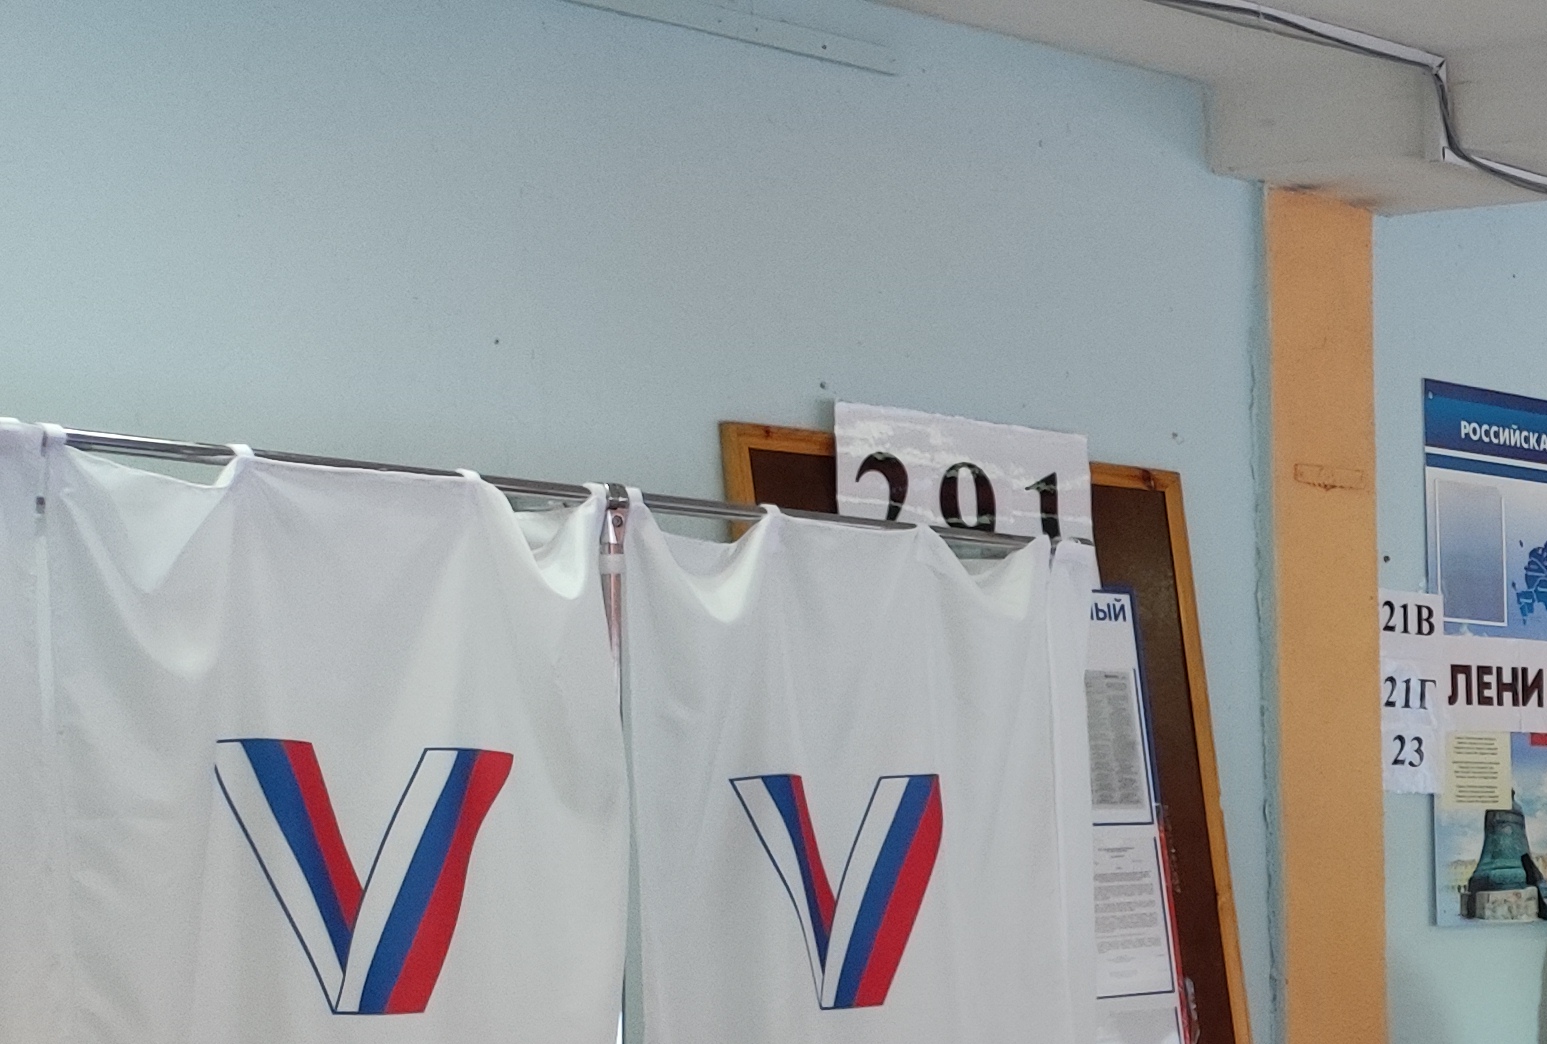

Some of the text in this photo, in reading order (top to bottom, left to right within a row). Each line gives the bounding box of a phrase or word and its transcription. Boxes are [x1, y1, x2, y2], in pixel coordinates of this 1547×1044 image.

[1381, 600, 1436, 637] 21В
[1384, 676, 1437, 711] 21Г
[1391, 734, 1425, 768] 23
